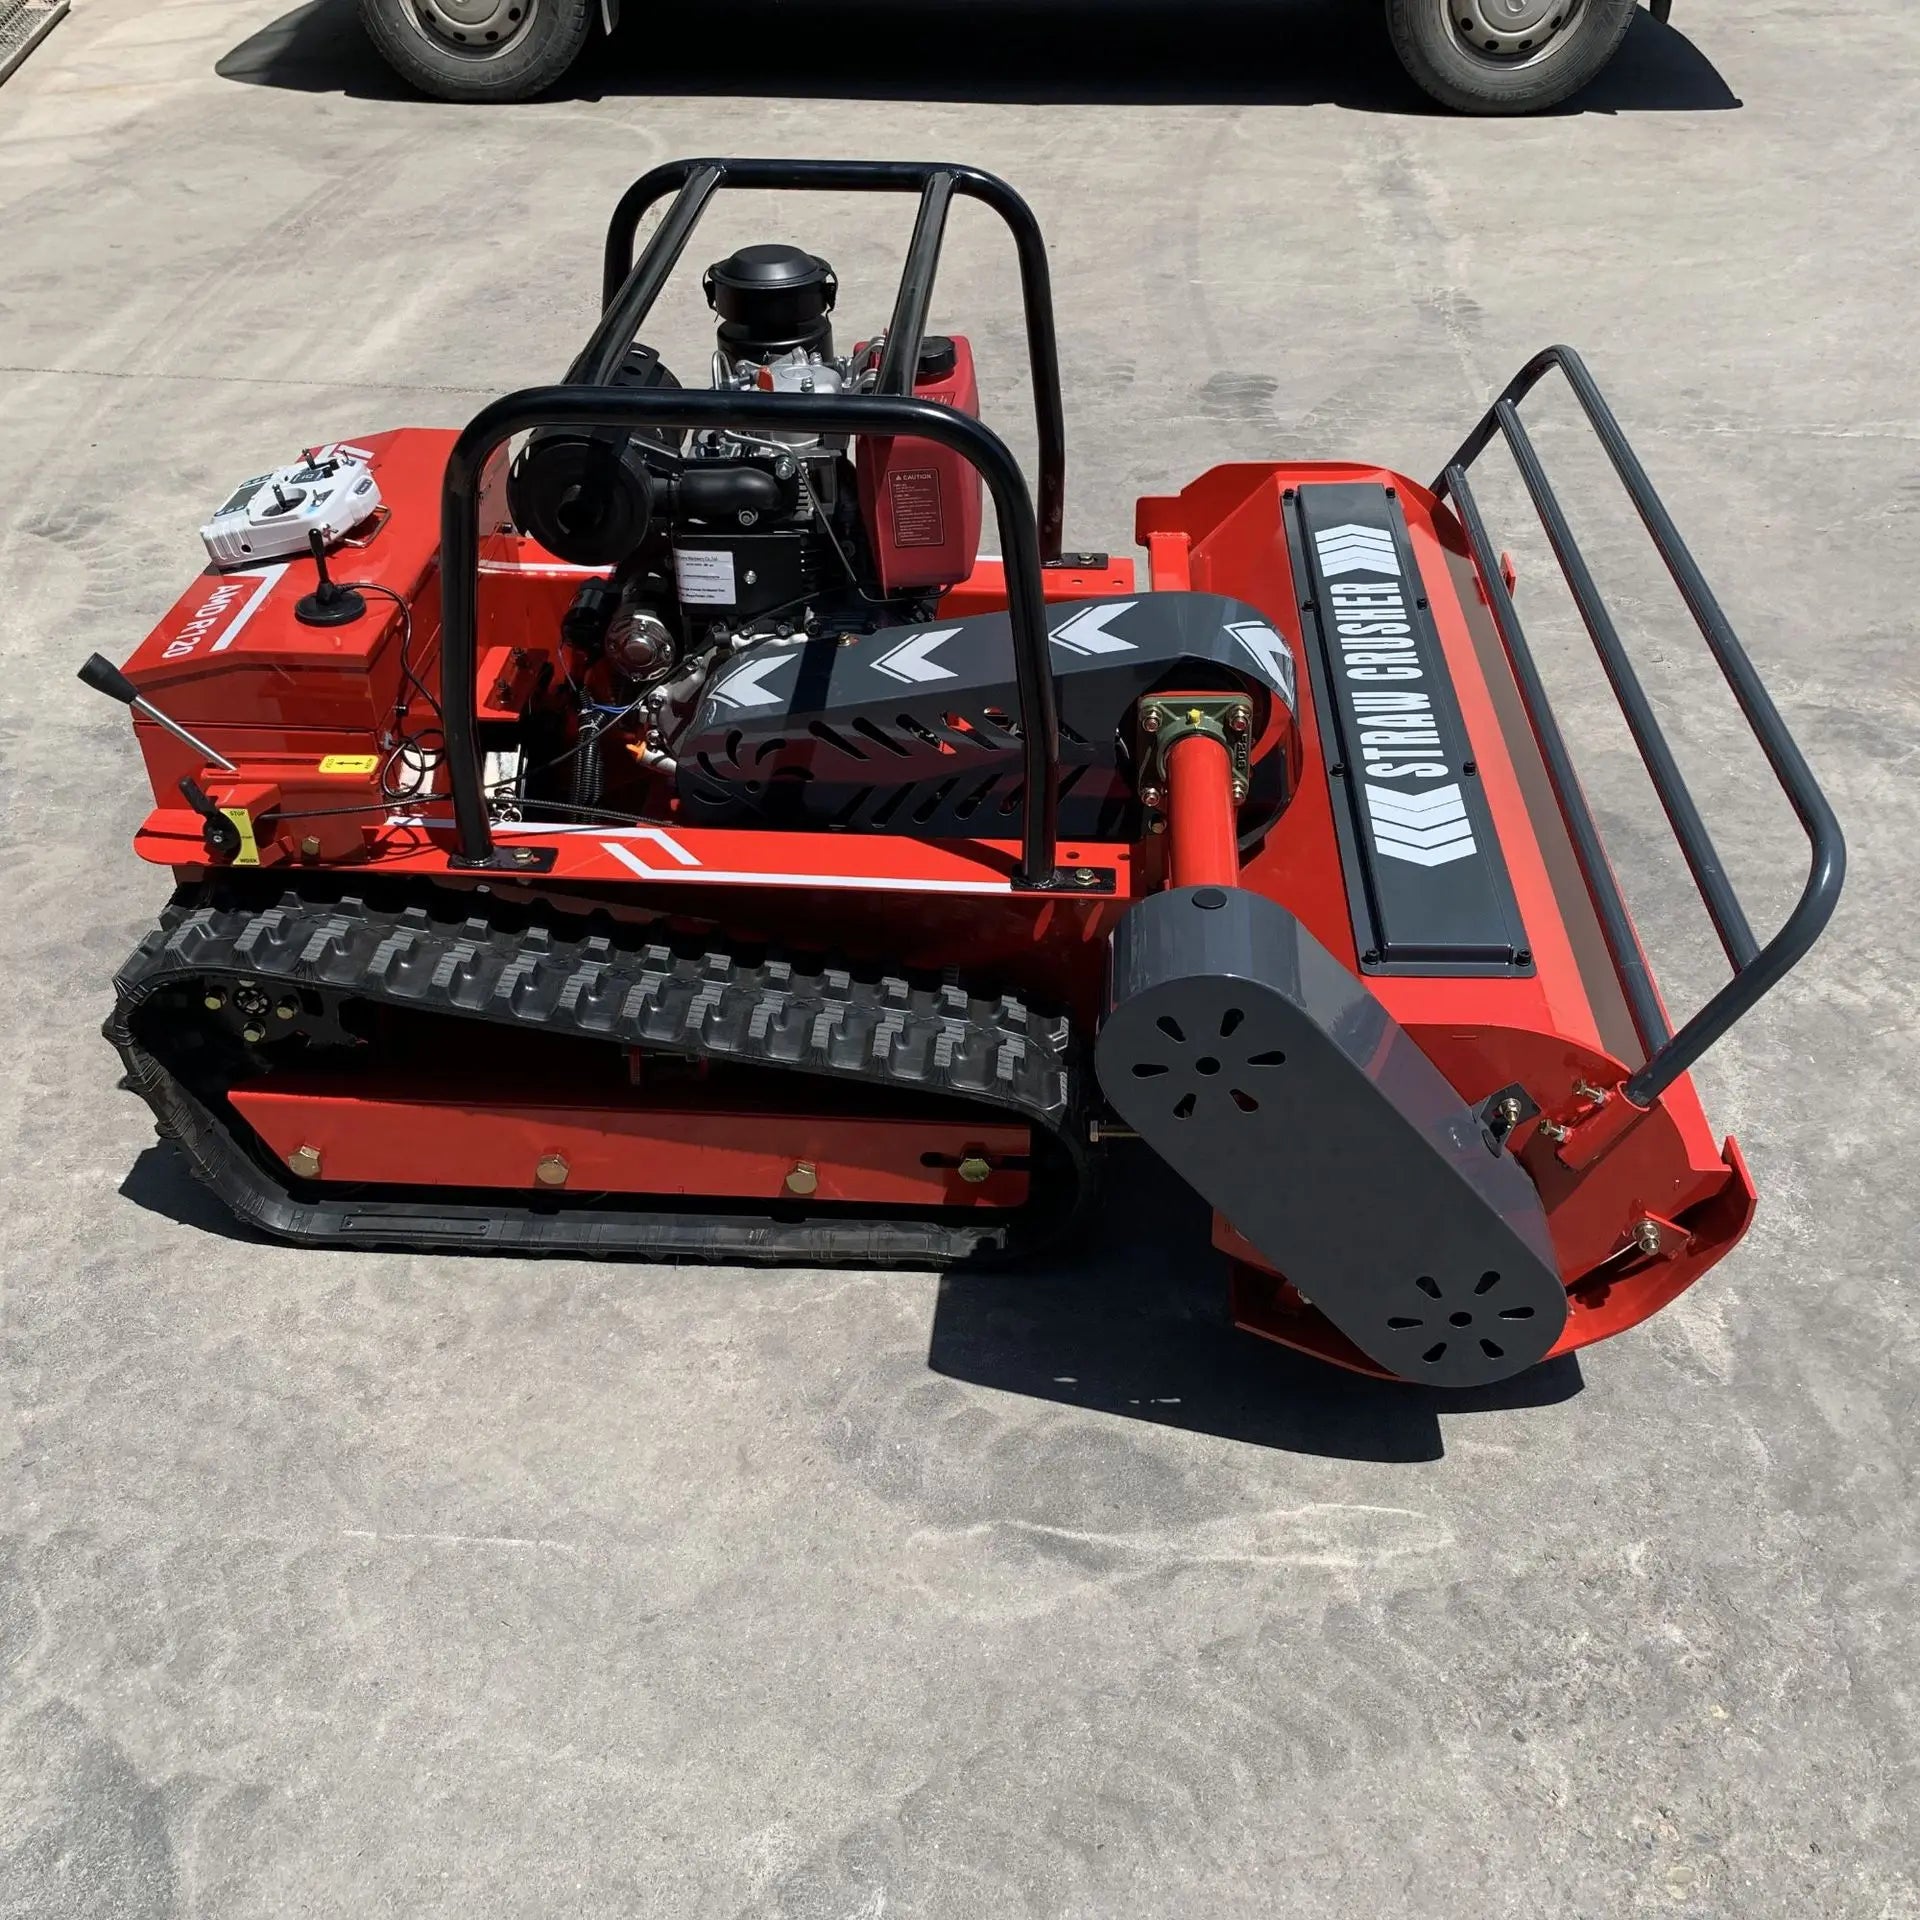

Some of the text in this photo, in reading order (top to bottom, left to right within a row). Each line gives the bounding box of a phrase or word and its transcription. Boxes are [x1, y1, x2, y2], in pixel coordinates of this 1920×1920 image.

[902, 473, 932, 481] CAUTION
[161, 584, 244, 659] AMD R120
[1330, 582, 1449, 778] STRAW CRUSHER
